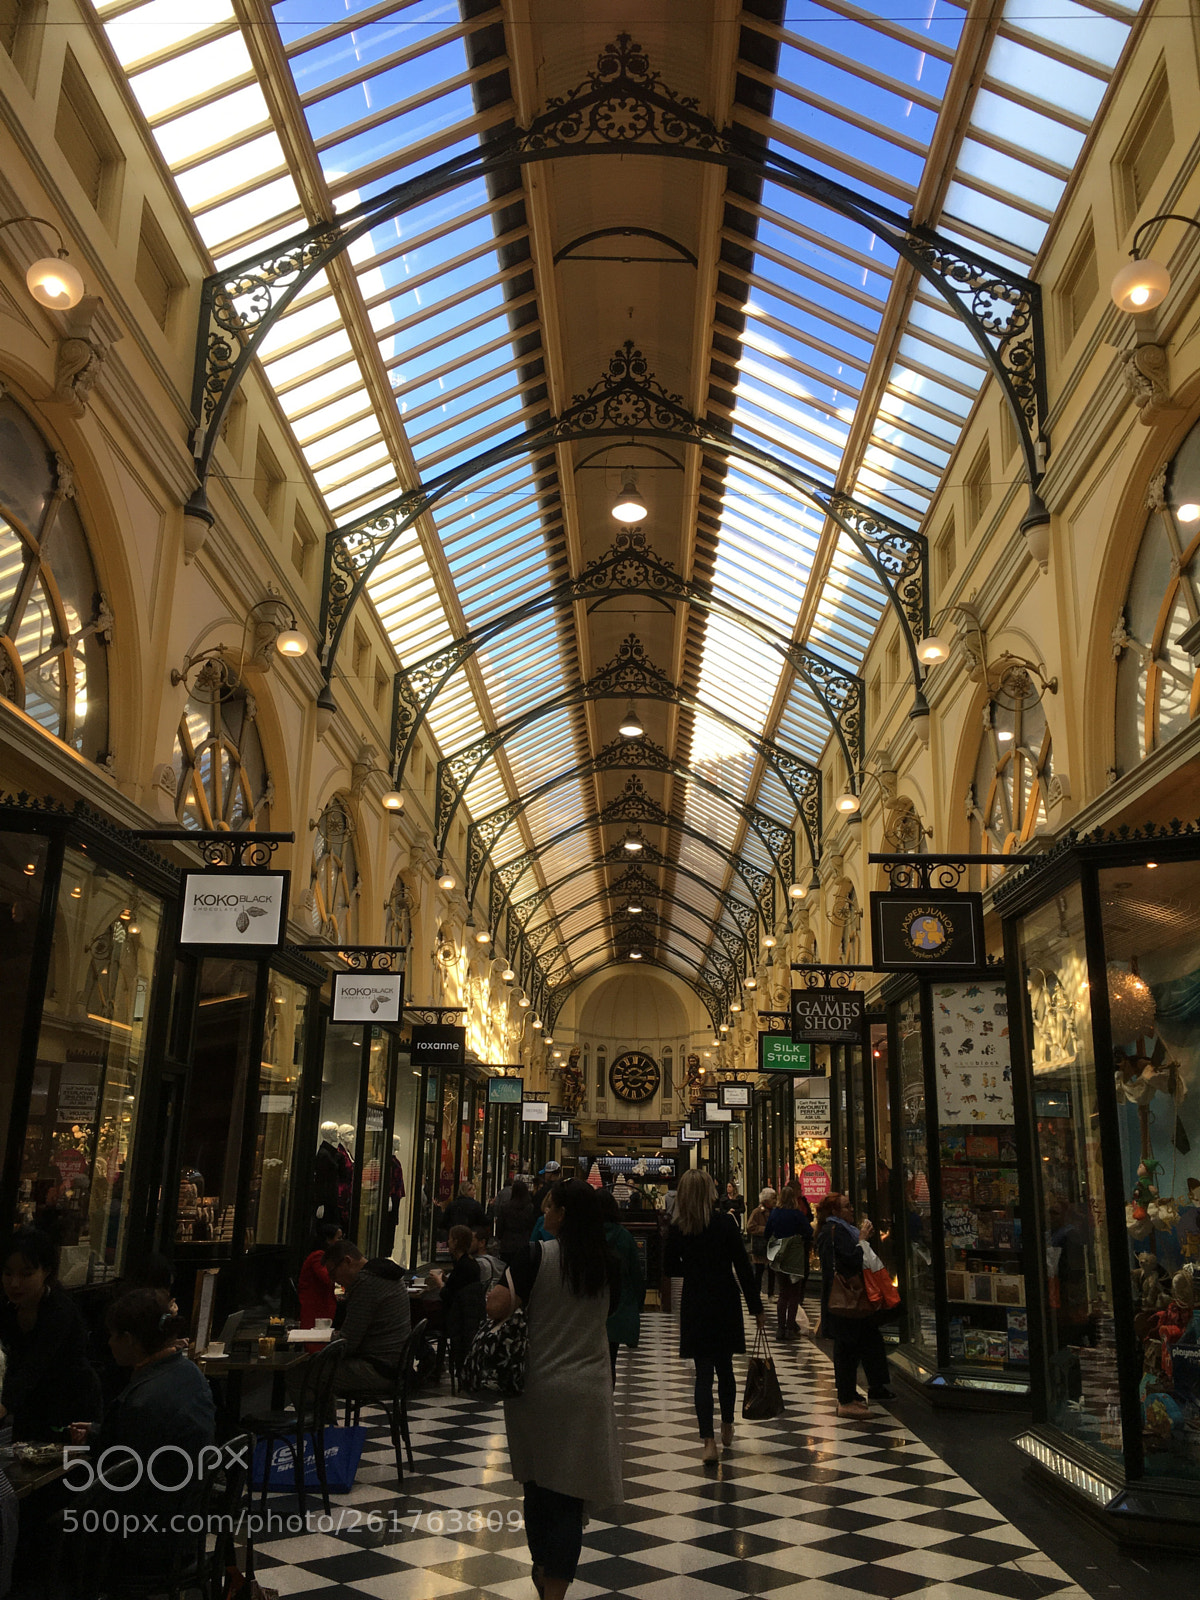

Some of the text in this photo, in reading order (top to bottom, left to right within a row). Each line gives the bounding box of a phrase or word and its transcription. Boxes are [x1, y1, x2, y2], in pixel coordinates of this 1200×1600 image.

[193, 894, 273, 906] KOKO BLACK
[901, 906, 954, 934] JASPER JUNIOR
[340, 987, 372, 996] KOKO
[820, 994, 836, 1002] THE
[796, 1001, 860, 1017] GAMES
[804, 1016, 852, 1030] SHOP
[416, 1042, 460, 1050] roxanne
[773, 1043, 801, 1053] SILK
[767, 1052, 807, 1063] STORE
